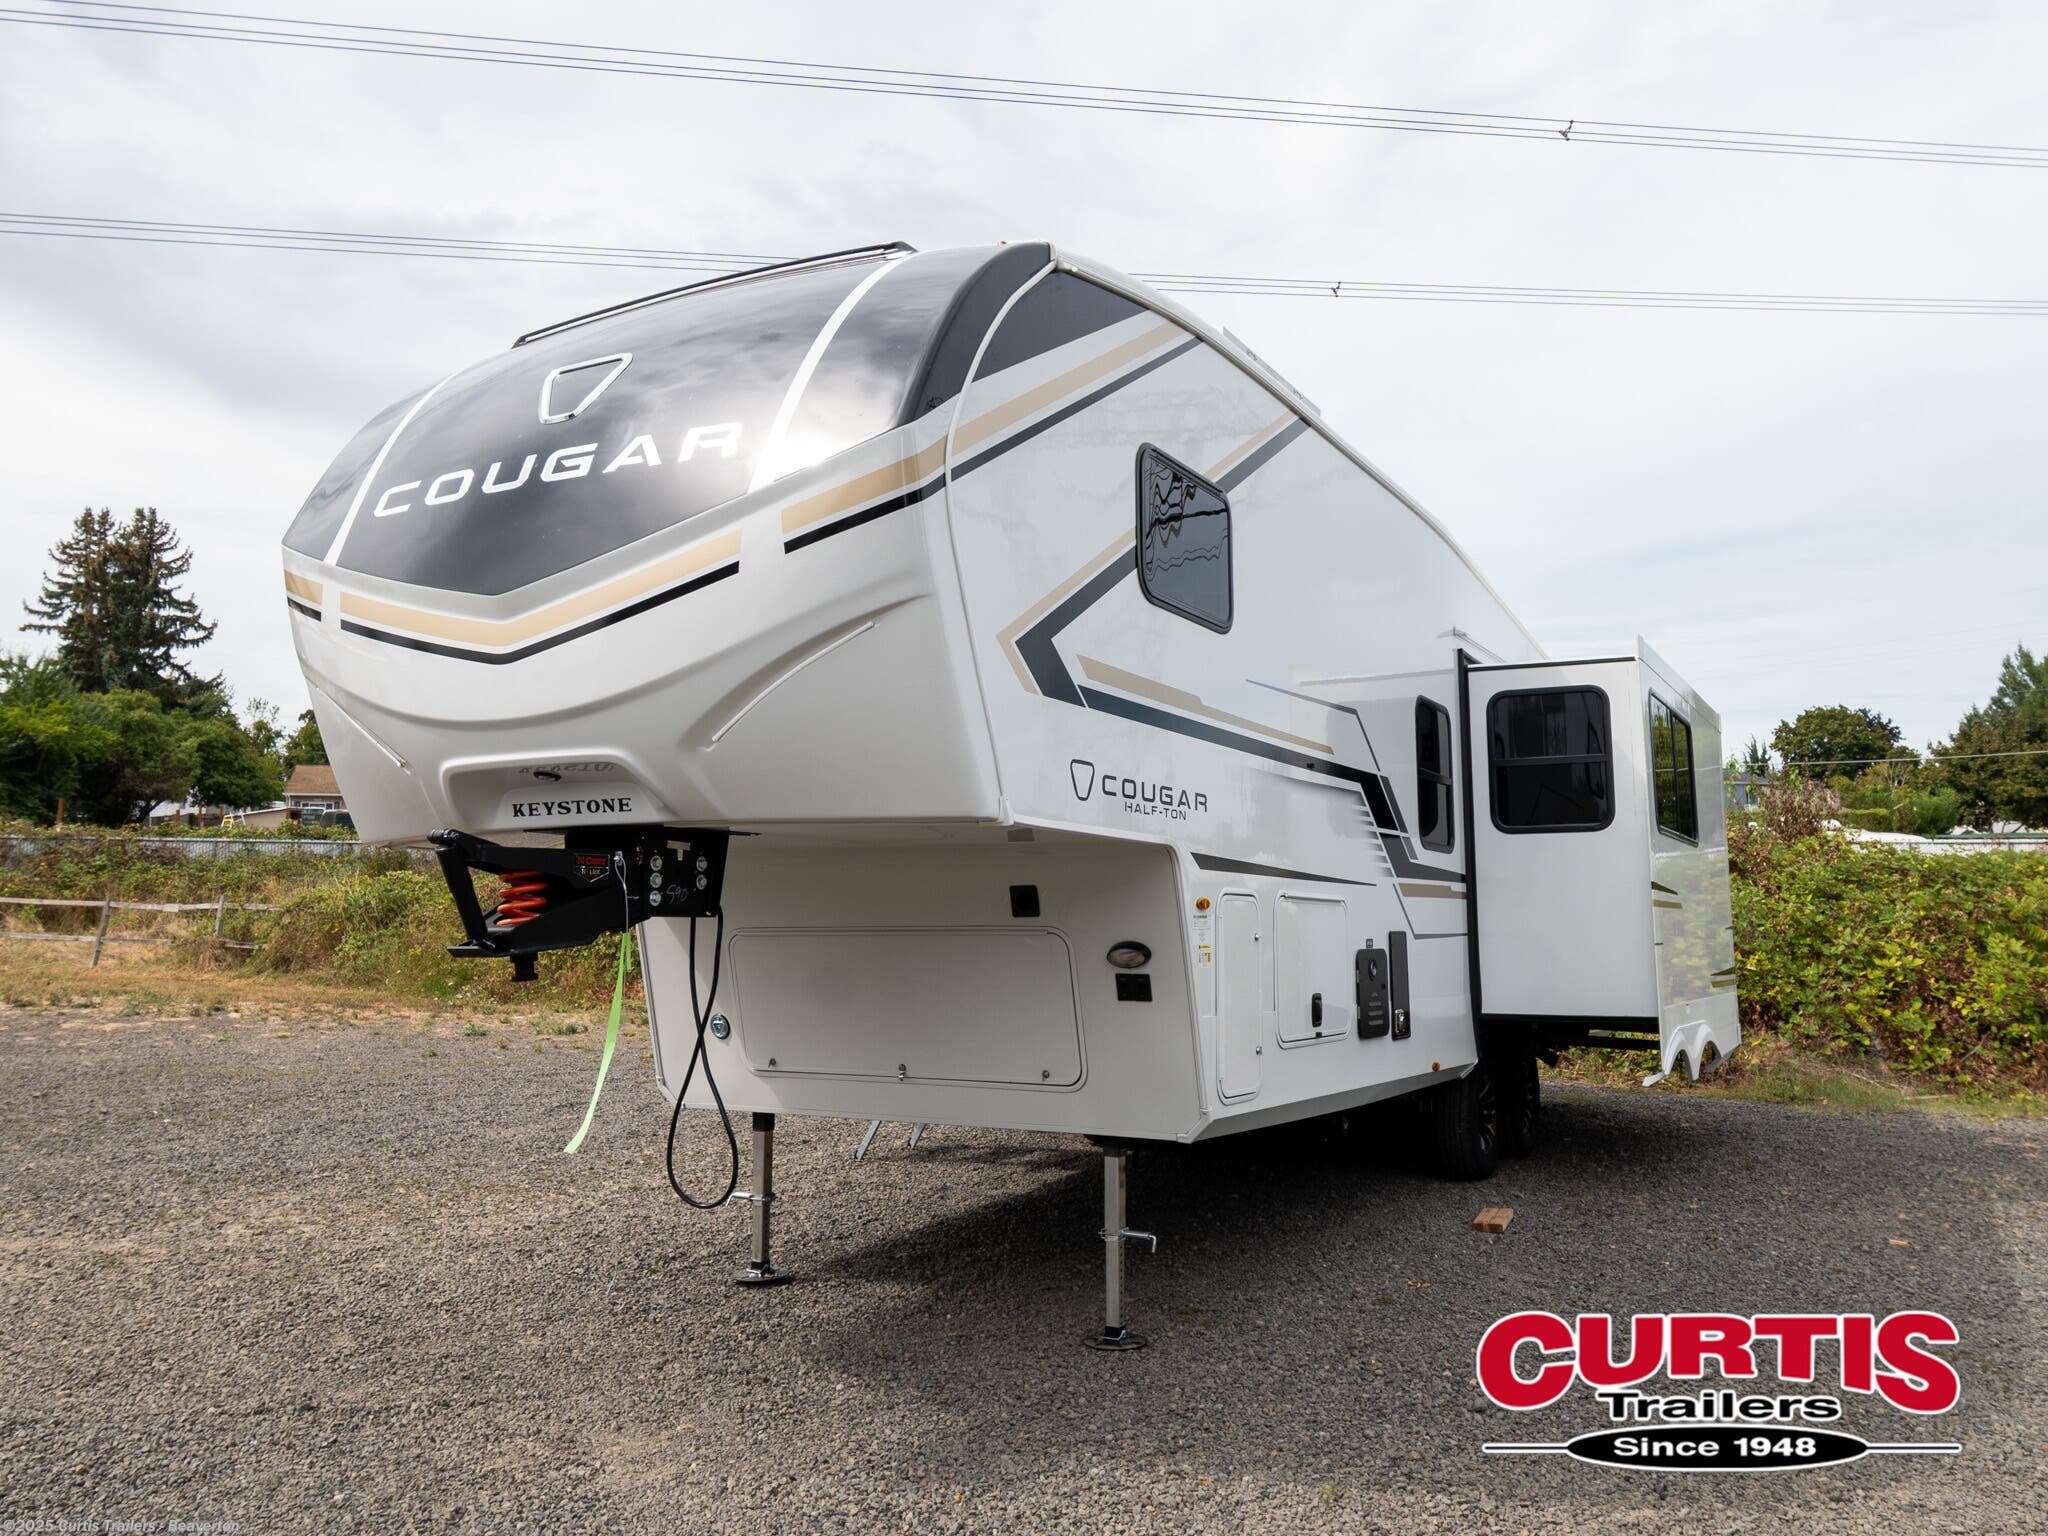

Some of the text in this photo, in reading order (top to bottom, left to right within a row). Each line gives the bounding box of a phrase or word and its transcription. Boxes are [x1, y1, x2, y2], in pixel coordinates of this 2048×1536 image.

[373, 421, 743, 518] COUGAR
[511, 797, 633, 818] KEYSTONE
[1102, 774, 1208, 813] COUGAR
[1124, 801, 1187, 821] HALF-TON
